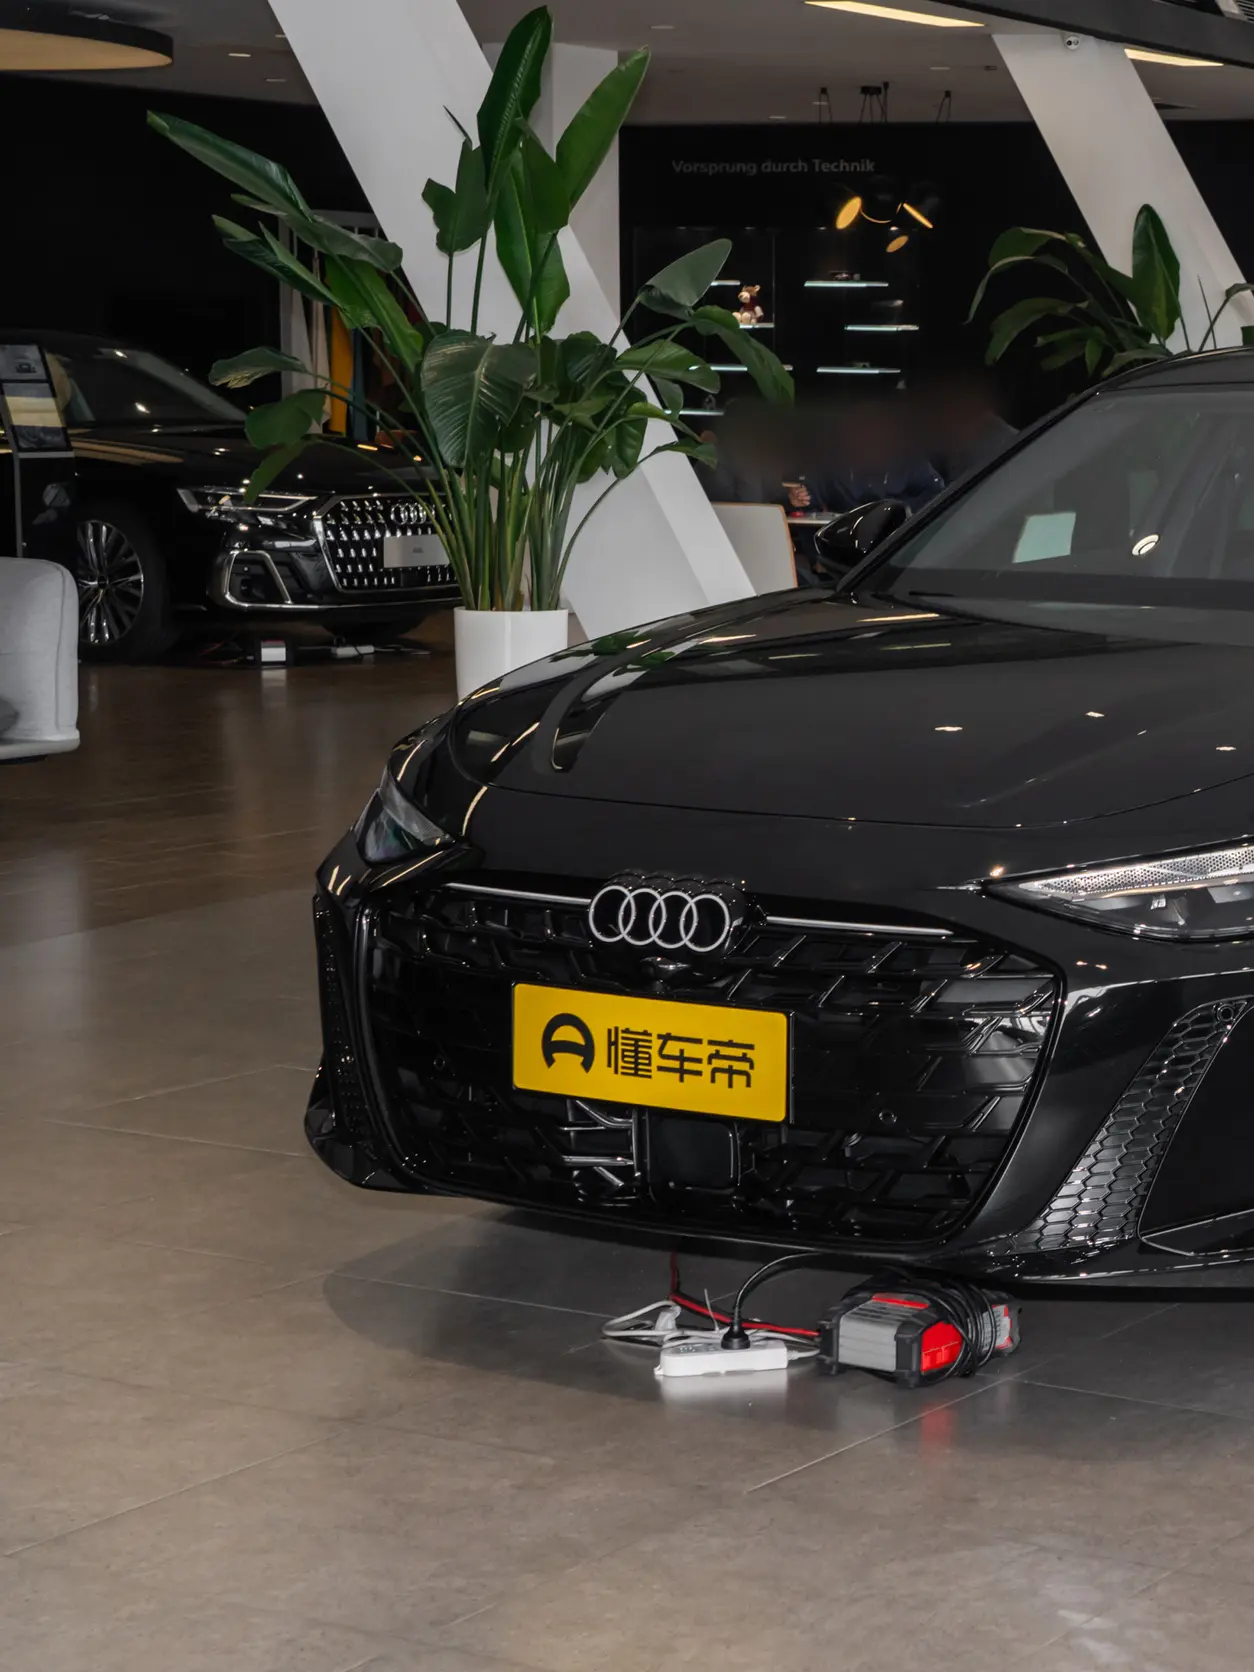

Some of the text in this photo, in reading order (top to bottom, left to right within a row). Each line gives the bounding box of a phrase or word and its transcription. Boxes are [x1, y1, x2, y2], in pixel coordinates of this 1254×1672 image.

[672, 157, 876, 176] Vorsprung durch Technik
[607, 1026, 755, 1089] 懂车帝
